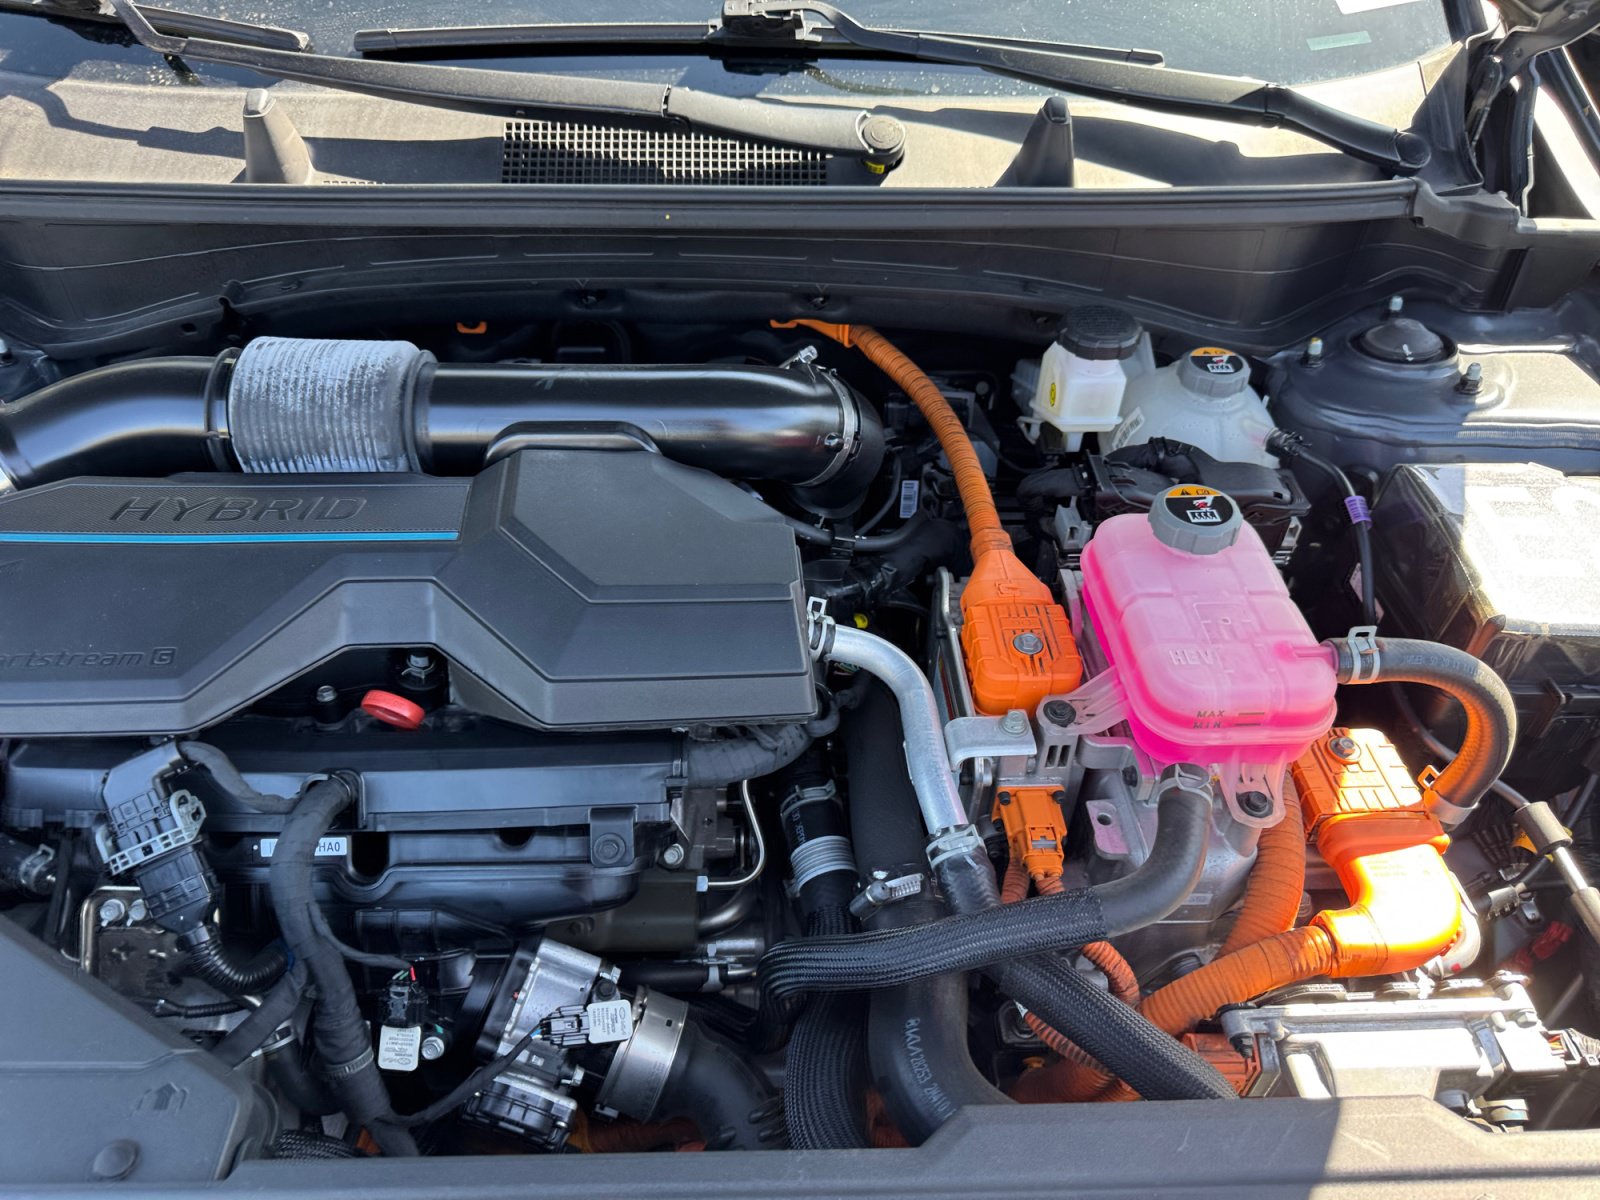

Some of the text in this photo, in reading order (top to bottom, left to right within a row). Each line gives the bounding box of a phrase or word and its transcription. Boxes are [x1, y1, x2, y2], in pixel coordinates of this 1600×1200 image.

[108, 495, 368, 522] HYBRID
[1168, 648, 1215, 666] HEV
[1196, 709, 1226, 719] MAX
[1192, 721, 1223, 729] MIN
[910, 1054, 933, 1084] 28253
